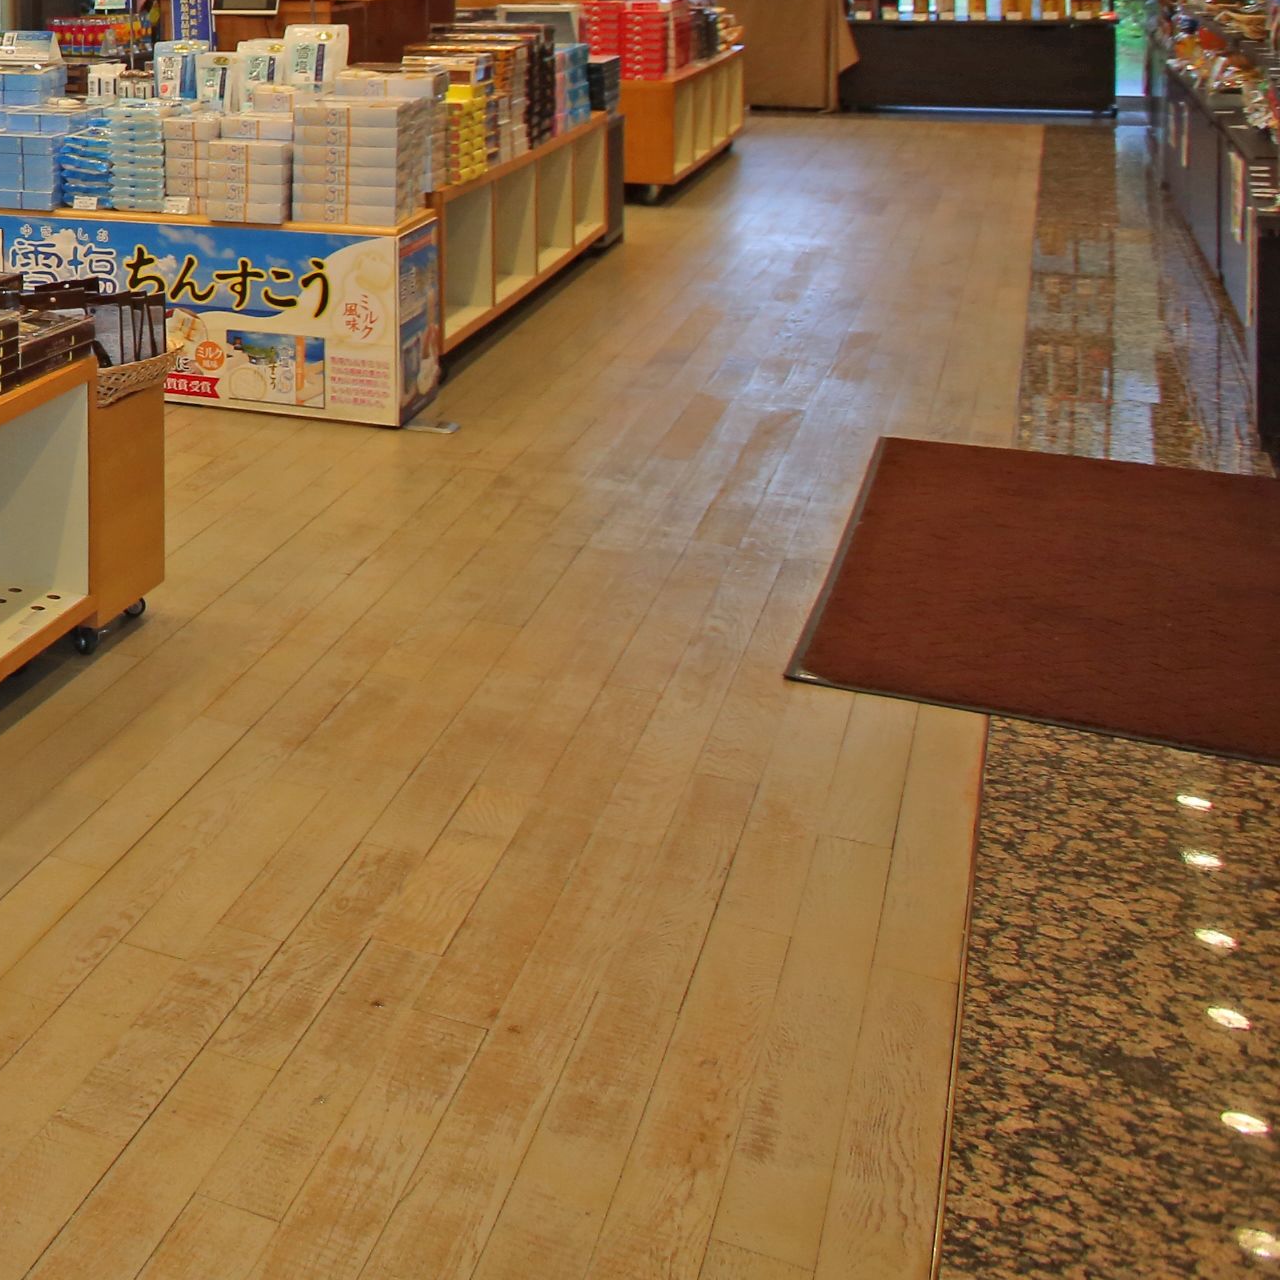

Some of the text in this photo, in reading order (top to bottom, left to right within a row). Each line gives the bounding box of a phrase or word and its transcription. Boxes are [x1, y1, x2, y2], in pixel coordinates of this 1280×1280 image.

[20, 223, 109, 243] ゆきしお
[343, 302, 361, 332] 風味
[361, 294, 379, 340] ミルク
[196, 346, 223, 359] ミルク
[164, 377, 212, 394] 質賞受賞
